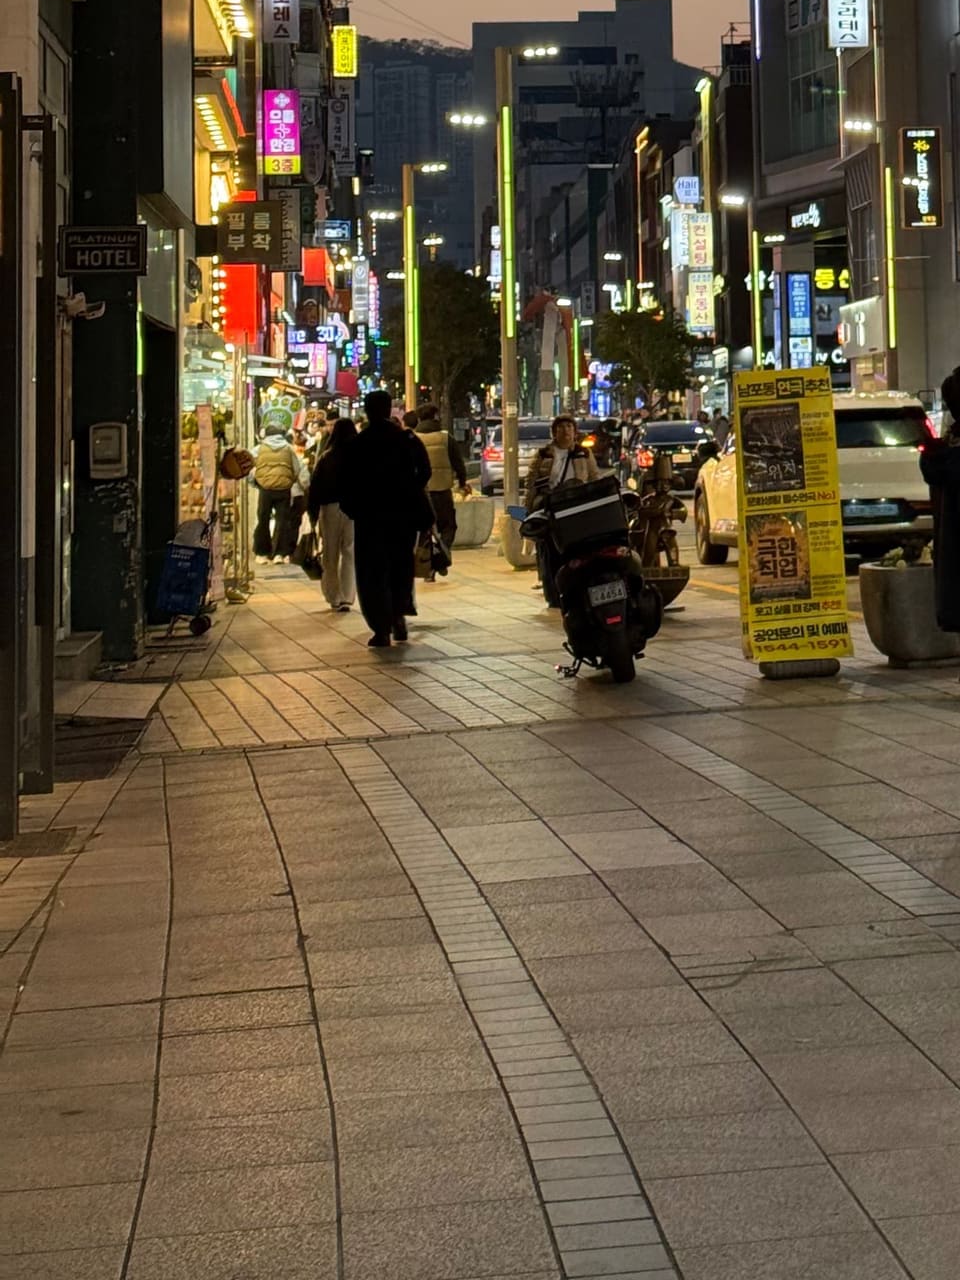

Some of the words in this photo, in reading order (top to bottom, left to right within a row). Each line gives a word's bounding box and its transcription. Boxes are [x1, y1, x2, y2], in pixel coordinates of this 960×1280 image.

[271, 159, 294, 172] 3층
[77, 249, 137, 267] HOTEL
[737, 382, 776, 398] 남포동
[804, 378, 830, 392] 추천
[758, 536, 797, 560] 극한
[753, 626, 805, 643] 공연문의
[807, 624, 820, 638] 및
[822, 622, 849, 636] 예매
[755, 638, 848, 653] 1544-1591
